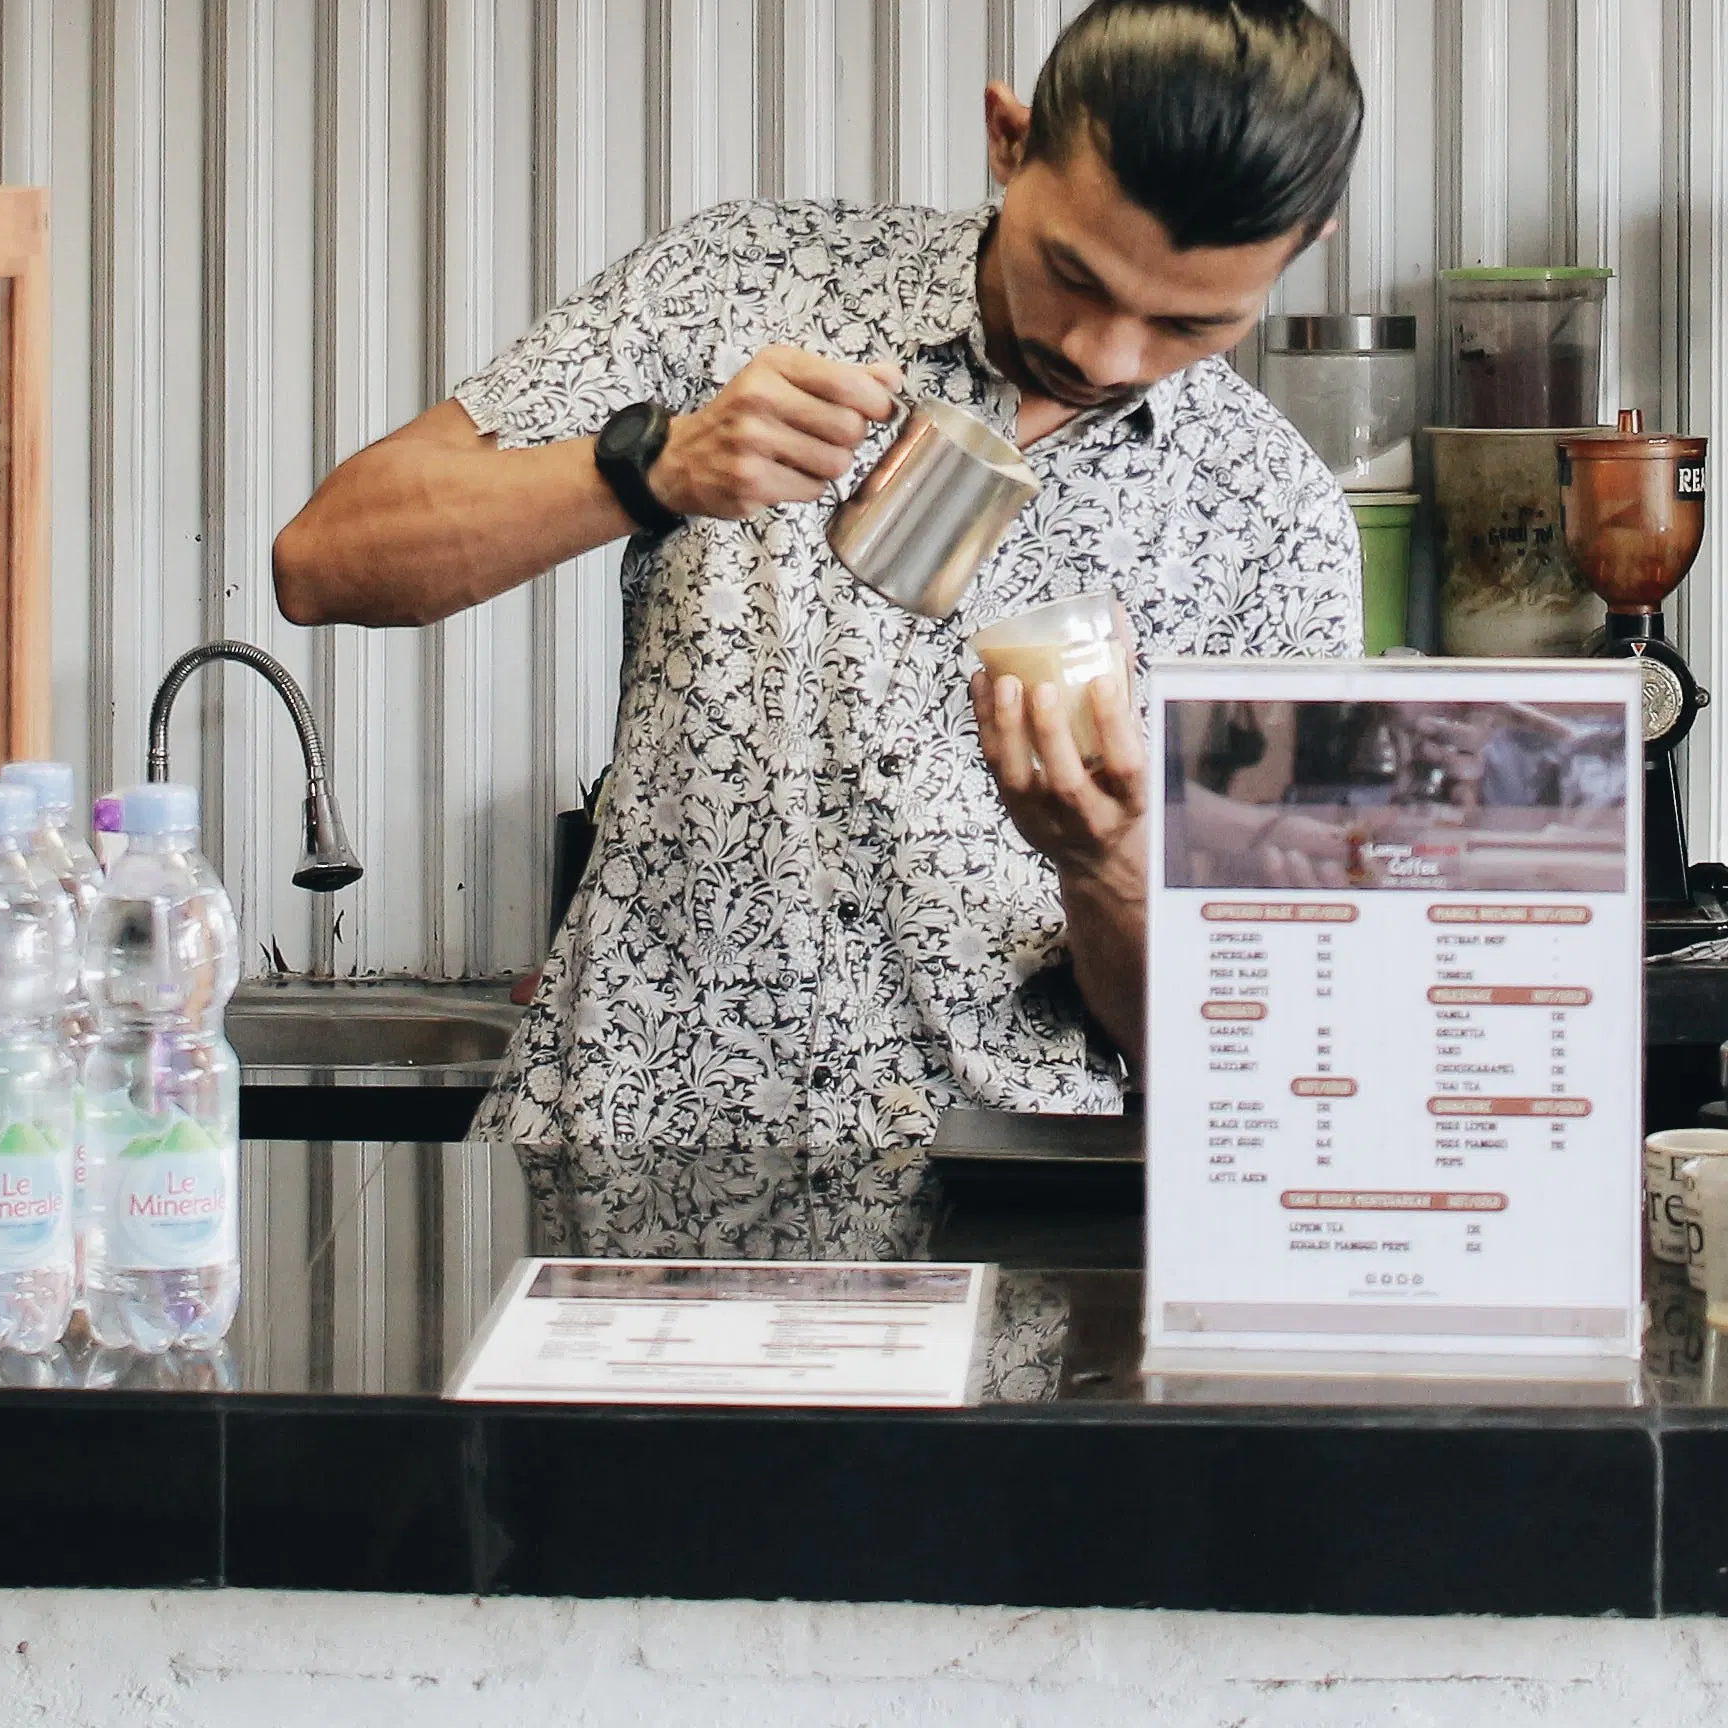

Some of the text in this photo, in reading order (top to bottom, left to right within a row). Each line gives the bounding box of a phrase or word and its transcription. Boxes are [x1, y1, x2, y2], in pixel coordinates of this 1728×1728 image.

[1, 1173, 32, 1197] Le
[167, 1171, 195, 1195] Le
[128, 1191, 225, 1217] Minerale
